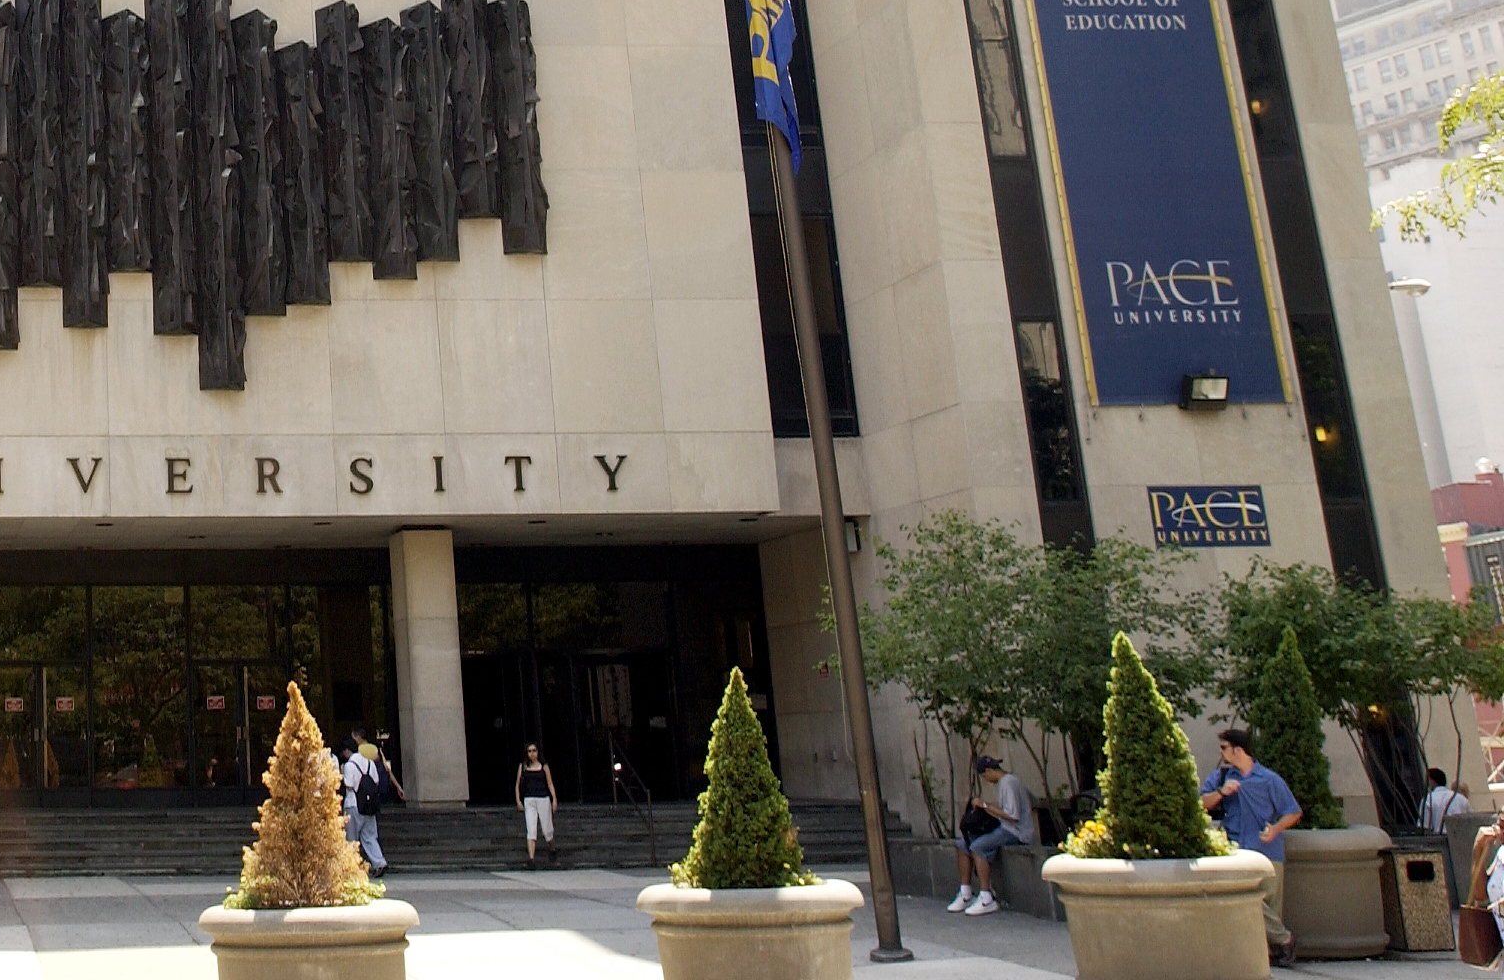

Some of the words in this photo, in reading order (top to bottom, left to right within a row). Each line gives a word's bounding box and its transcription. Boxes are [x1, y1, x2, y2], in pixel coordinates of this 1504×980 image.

[1065, 13, 1187, 31] EDUCATION
[1106, 259, 1240, 307] PACE
[1113, 309, 1242, 325] UNIVERSITY
[1150, 490, 1266, 528] PACE
[1156, 529, 1268, 543] UNIVERSITY
